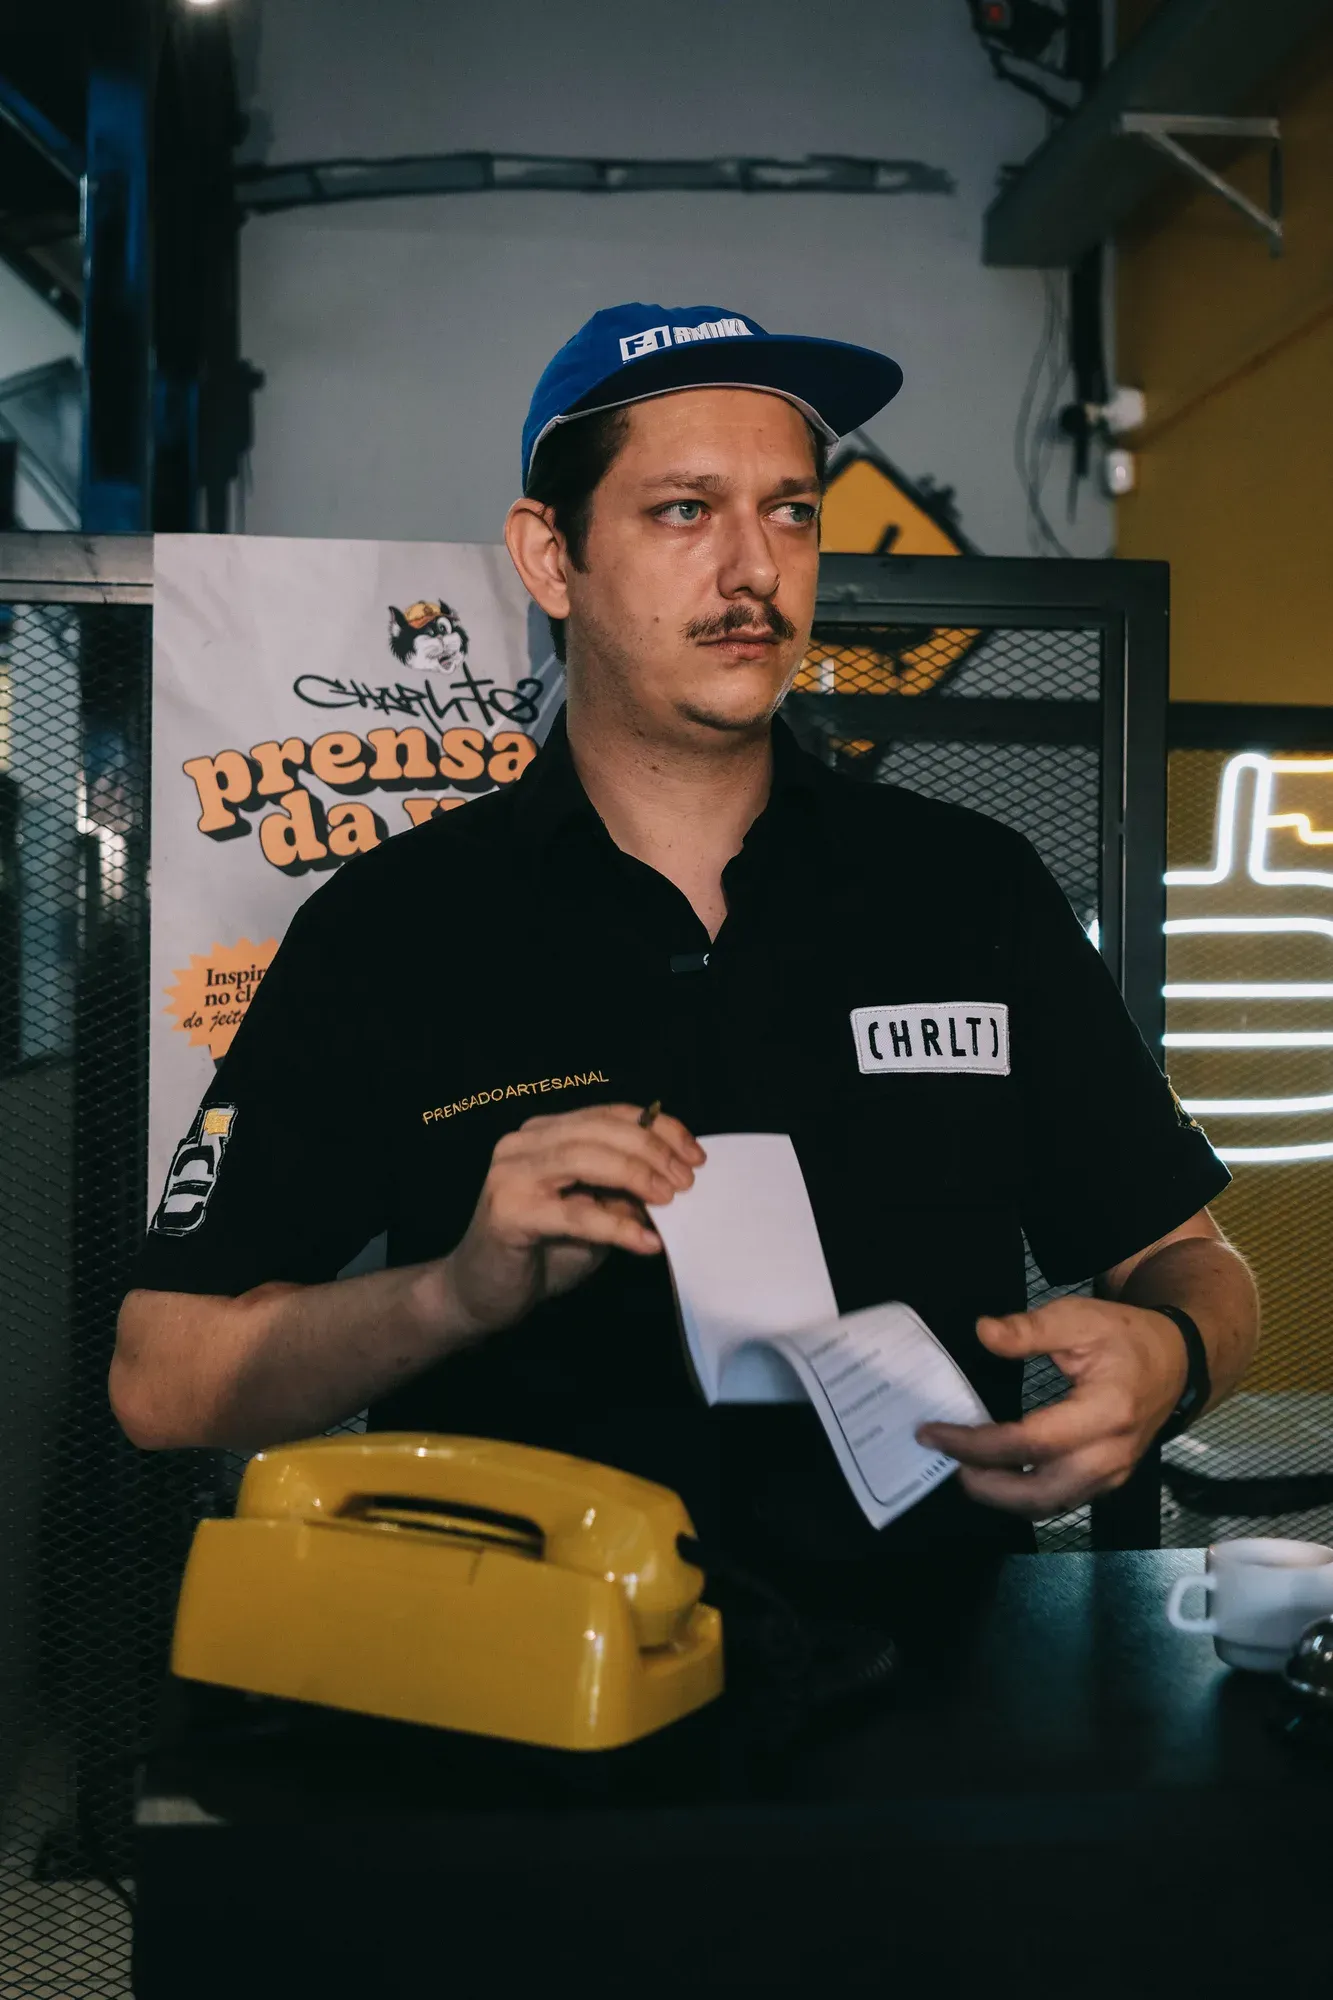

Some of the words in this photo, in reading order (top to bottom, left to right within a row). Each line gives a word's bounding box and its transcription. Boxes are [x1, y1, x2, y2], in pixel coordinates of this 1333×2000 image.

[624, 329, 668, 357] F-1
[259, 789, 387, 872] da
[204, 991, 231, 1007] no
[235, 983, 254, 1003] cl
[182, 1010, 203, 1029] do
